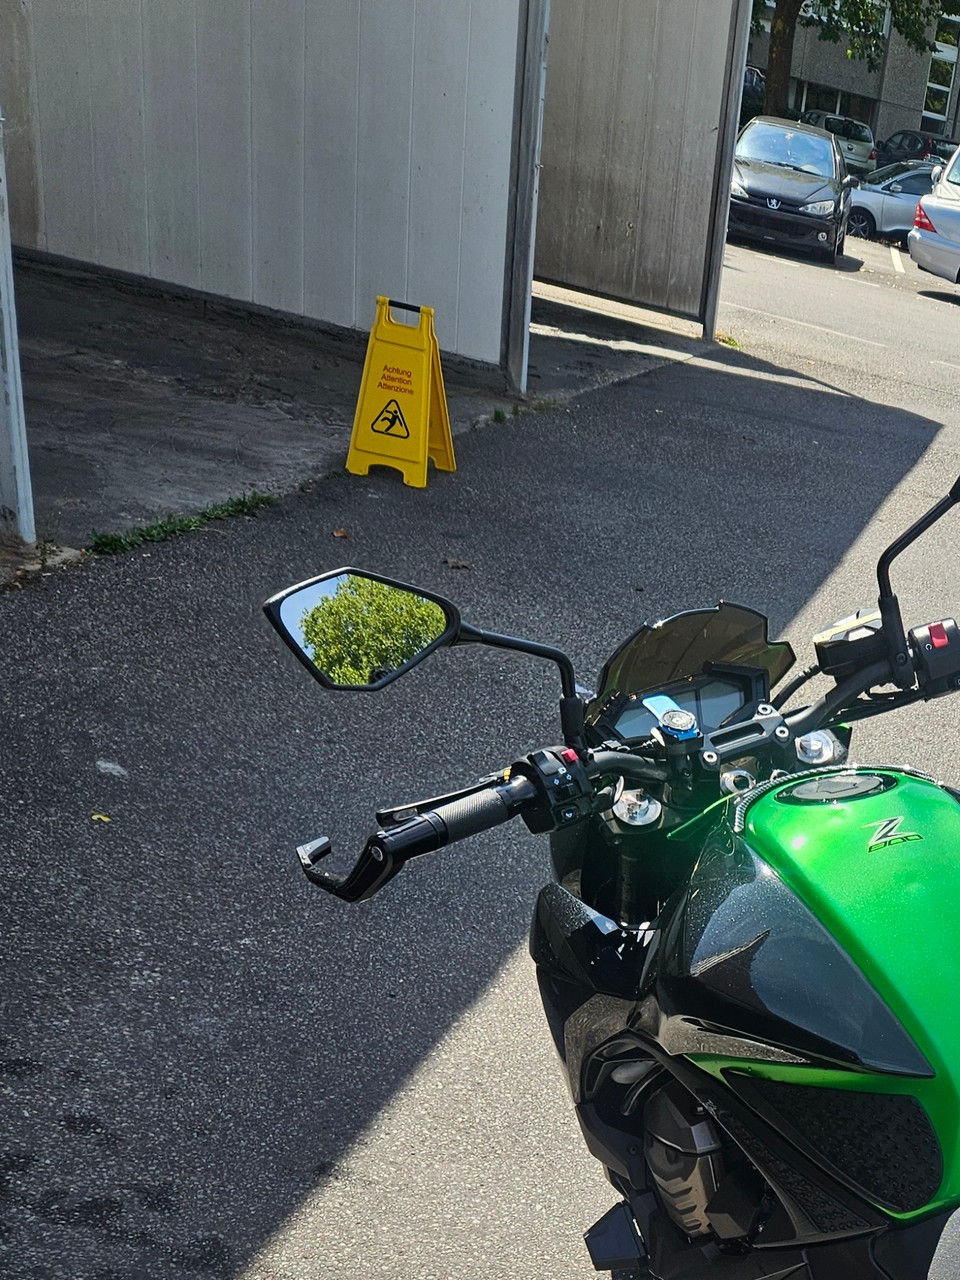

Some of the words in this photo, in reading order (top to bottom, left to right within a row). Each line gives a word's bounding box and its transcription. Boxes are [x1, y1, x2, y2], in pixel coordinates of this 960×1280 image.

[380, 373, 412, 385] Attention
[383, 365, 412, 378] Achtung
[862, 816, 918, 845] Z
[868, 834, 924, 853] 800
